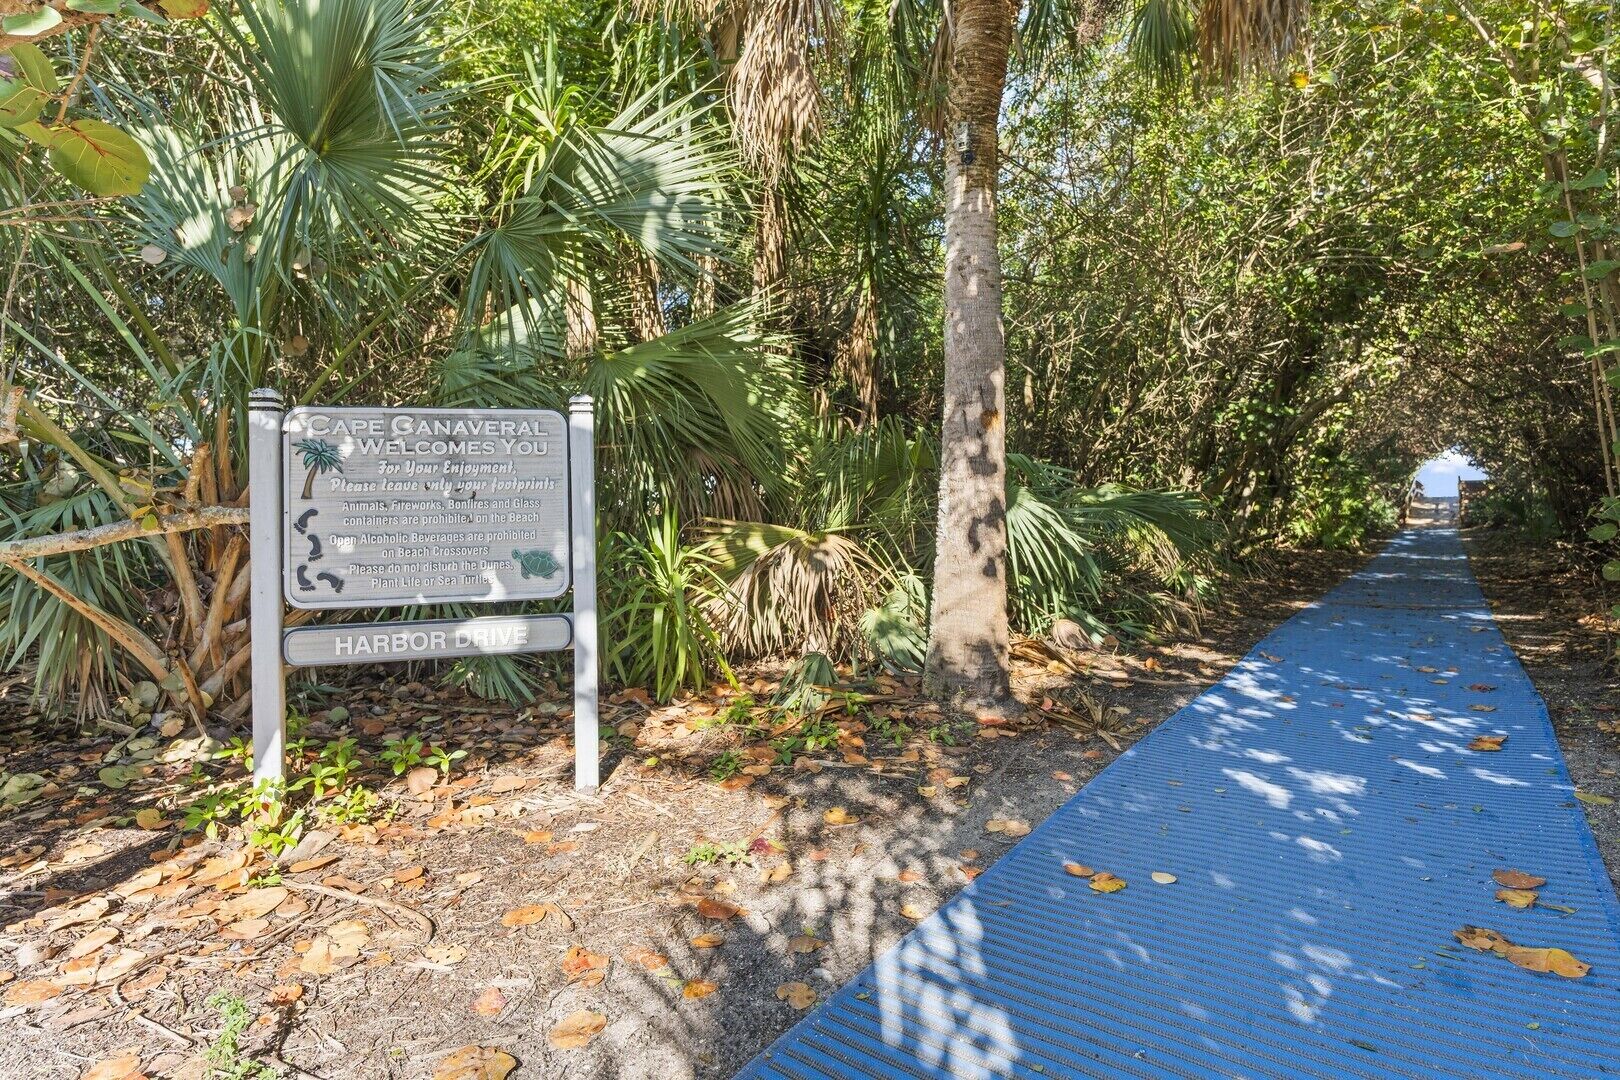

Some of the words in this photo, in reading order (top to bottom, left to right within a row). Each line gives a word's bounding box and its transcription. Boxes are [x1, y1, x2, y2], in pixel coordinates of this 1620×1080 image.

[307, 415, 385, 436] CAPE
[391, 415, 548, 436] CANAVERAL
[357, 438, 495, 454] WELCOMES
[500, 438, 549, 455] YOU
[379, 460, 401, 475] For
[405, 460, 439, 477] Your
[330, 477, 377, 492] Please
[381, 479, 418, 491] leave
[457, 481, 488, 493] your
[490, 477, 556, 493] footprints
[342, 501, 389, 512] Animals,
[391, 500, 446, 511] Fireworks,
[448, 499, 491, 510] Bonfires
[492, 499, 510, 509] and
[513, 498, 541, 509] Glass
[343, 515, 399, 527] containers
[402, 515, 419, 525] are
[476, 514, 489, 523] on
[491, 513, 507, 523] the
[509, 512, 540, 523] Beach
[329, 534, 357, 547] Open
[360, 533, 408, 545] Alcoholic
[411, 532, 465, 544] Beverages
[468, 533, 485, 542] are
[487, 530, 537, 543] prohibited
[382, 548, 396, 559] on
[398, 547, 430, 558] Beach
[433, 545, 490, 557] Crossovers
[349, 564, 385, 575] Please
[388, 563, 402, 574] do
[404, 562, 420, 573] not
[423, 560, 459, 573] disturb
[462, 560, 478, 571] the
[371, 578, 399, 589] Plant
[402, 576, 421, 588] Life
[424, 577, 436, 587] or
[438, 575, 458, 586] Sea
[335, 631, 446, 655] HARBOR
[454, 624, 528, 649] DRIVE
